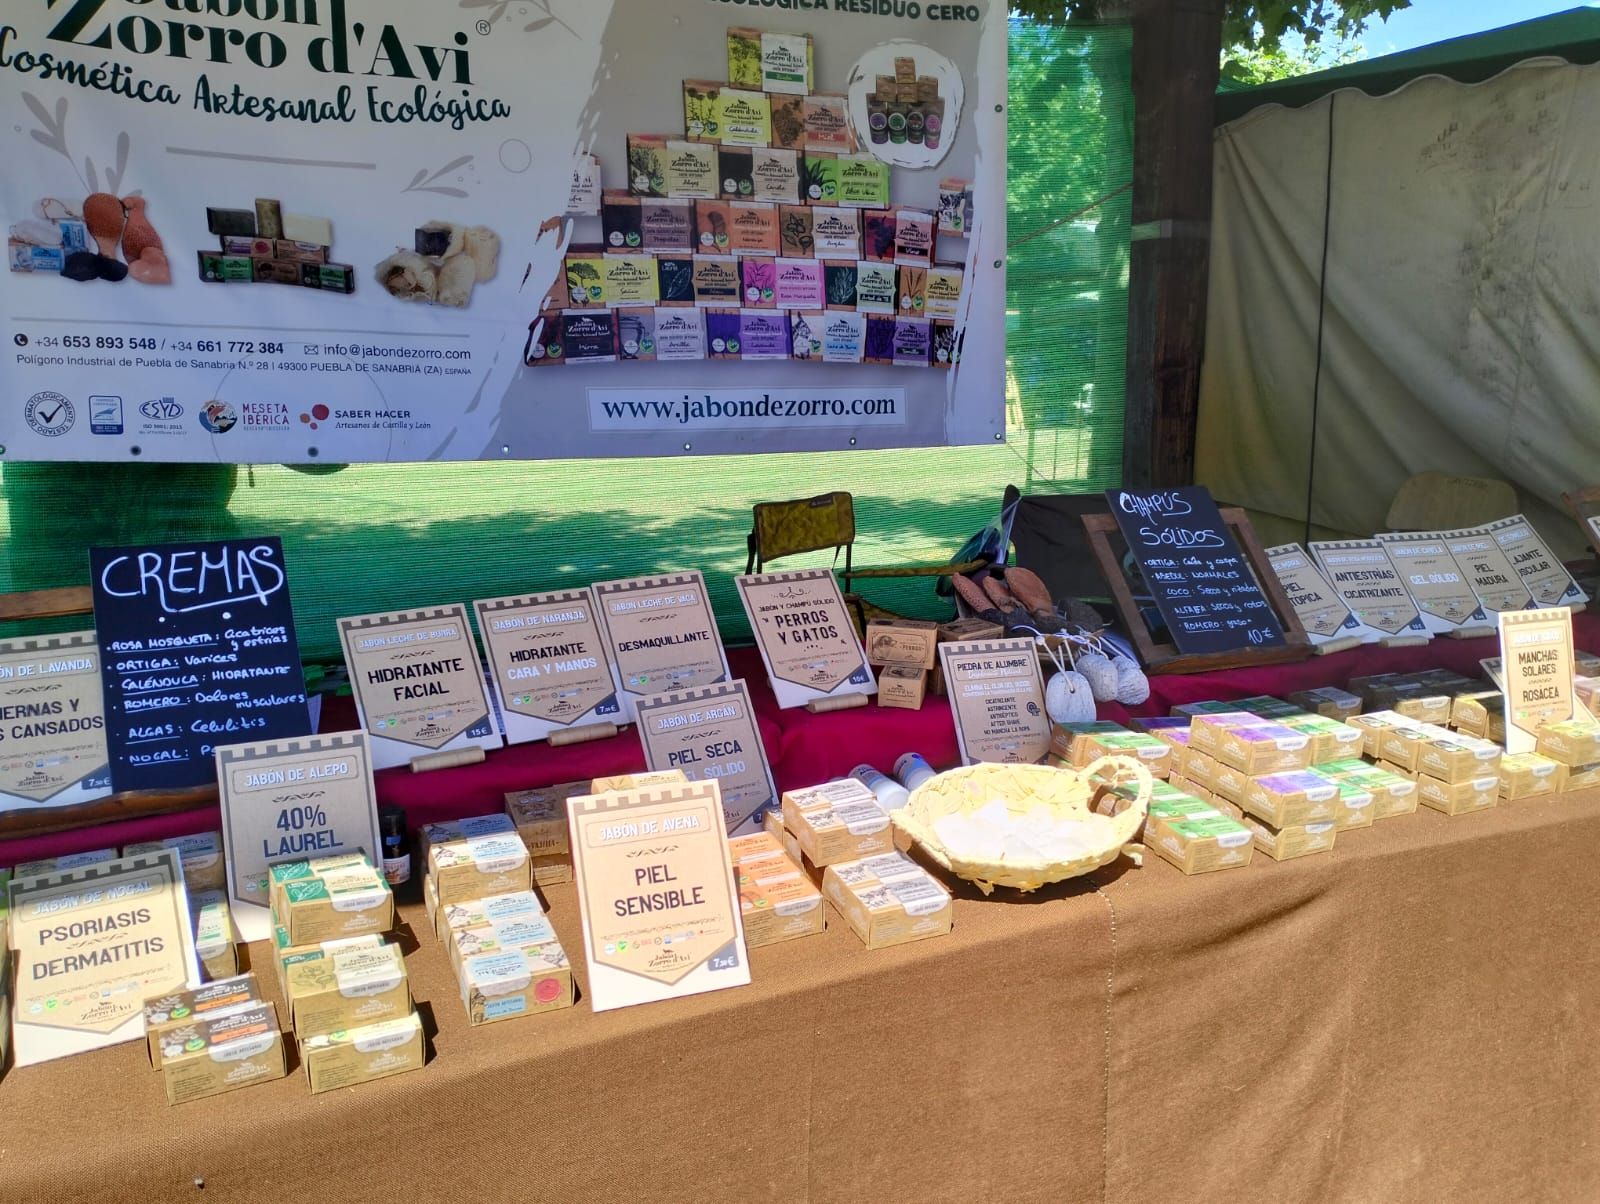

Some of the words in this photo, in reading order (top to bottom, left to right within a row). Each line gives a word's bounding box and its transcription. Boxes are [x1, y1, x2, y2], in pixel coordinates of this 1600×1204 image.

[835, 0, 921, 20] RESIDUO
[927, 5, 980, 22] CERO
[46, 0, 287, 68] Zorro
[307, 0, 475, 85] d'Avi
[0, 26, 181, 105] Cosmética
[194, 74, 356, 123] Artesanal
[366, 85, 511, 130] Ecológica
[35, 336, 59, 348] +34
[63, 336, 91, 349] 653
[96, 337, 124, 349] 893
[129, 337, 157, 350] 548
[171, 341, 193, 351] +34
[197, 340, 222, 353] 661
[228, 341, 254, 354] 772
[258, 342, 284, 354] 384
[324, 344, 471, 360] info@jabondezorro.com
[16, 354, 64, 367] Polígono
[67, 356, 116, 367] Industrial
[119, 357, 133, 367] de
[135, 357, 171, 368] Puebla
[175, 358, 188, 368] de
[190, 359, 236, 369] Sanabria
[256, 361, 269, 370] 28
[277, 362, 308, 372] 49300
[310, 362, 352, 372] PUEBLA
[355, 363, 370, 372] DE
[372, 364, 421, 374] SANABRIA
[423, 364, 443, 376] (ZA)
[242, 403, 289, 414] MESETA
[242, 411, 290, 426] IBÉRICA
[335, 410, 371, 419] SABER
[375, 410, 411, 419] HACER
[602, 395, 896, 424] www.jabondezorro.com
[372, 421, 380, 429] de
[415, 421, 431, 430] León
[1140, 526, 1225, 550] SÓLIDOS
[101, 545, 285, 611] CREMAS
[1473, 563, 1494, 574] PIEL
[1475, 574, 1509, 587] MADURA
[638, 598, 663, 609] LECHE
[664, 596, 676, 605] DE
[1290, 592, 1323, 607] TÓPICA
[1343, 587, 1404, 600] CICATRIZANTE
[758, 603, 779, 613] JABÓN
[493, 616, 525, 631] JABÓN
[527, 616, 541, 626] DE
[543, 610, 585, 624] NARANJA
[774, 610, 829, 629] PERROS
[417, 632, 428, 640] DE
[618, 630, 710, 652] DESMAQUILLANTE
[777, 631, 787, 645] Y
[792, 625, 839, 643] GATOS
[112, 641, 143, 650] ROSA
[510, 641, 588, 663] HIDRATANTE
[18, 664, 36, 676] DE
[39, 658, 93, 674] LAVANDA
[185, 653, 238, 666] Varices
[957, 661, 982, 672] PIEDRA
[983, 661, 994, 670] DE
[995, 658, 1028, 669] ALUMBRE
[1518, 649, 1559, 665] MANCHAS
[212, 666, 291, 681] HIDRATANTE
[367, 658, 464, 684] HIDRATANTE
[506, 665, 540, 681] CARA
[543, 663, 552, 675] Y
[556, 657, 598, 674] MANOS
[1522, 664, 1557, 677] SOLARES
[195, 689, 249, 703] Dolores
[236, 693, 305, 709] musculares
[393, 681, 450, 701] FACIAL
[69, 698, 80, 712] Y
[190, 717, 266, 733] Celulitis
[658, 713, 688, 729] JABÓN
[689, 711, 703, 723] DE
[706, 703, 737, 720] ARGÁN
[11, 715, 104, 740] CANSADOS
[668, 748, 702, 767] PIEL
[704, 739, 743, 759] SECA
[244, 769, 285, 788] JABÓN
[288, 767, 305, 781] DE
[309, 761, 349, 779] ALEPO
[703, 760, 747, 779] SÓLIDO
[276, 804, 327, 832] 40%
[600, 821, 639, 842] JABÓN
[641, 819, 659, 834] DE
[663, 815, 701, 832] AVENA
[263, 829, 344, 858] LAUREL
[635, 863, 678, 886] PIEL
[31, 895, 80, 916] JABÓN
[83, 889, 103, 904] DE
[107, 879, 153, 900] NOGAL
[614, 886, 706, 917] SENSIBLE
[39, 908, 152, 946] PSORIASIS
[32, 937, 165, 981] DERMATITIS
